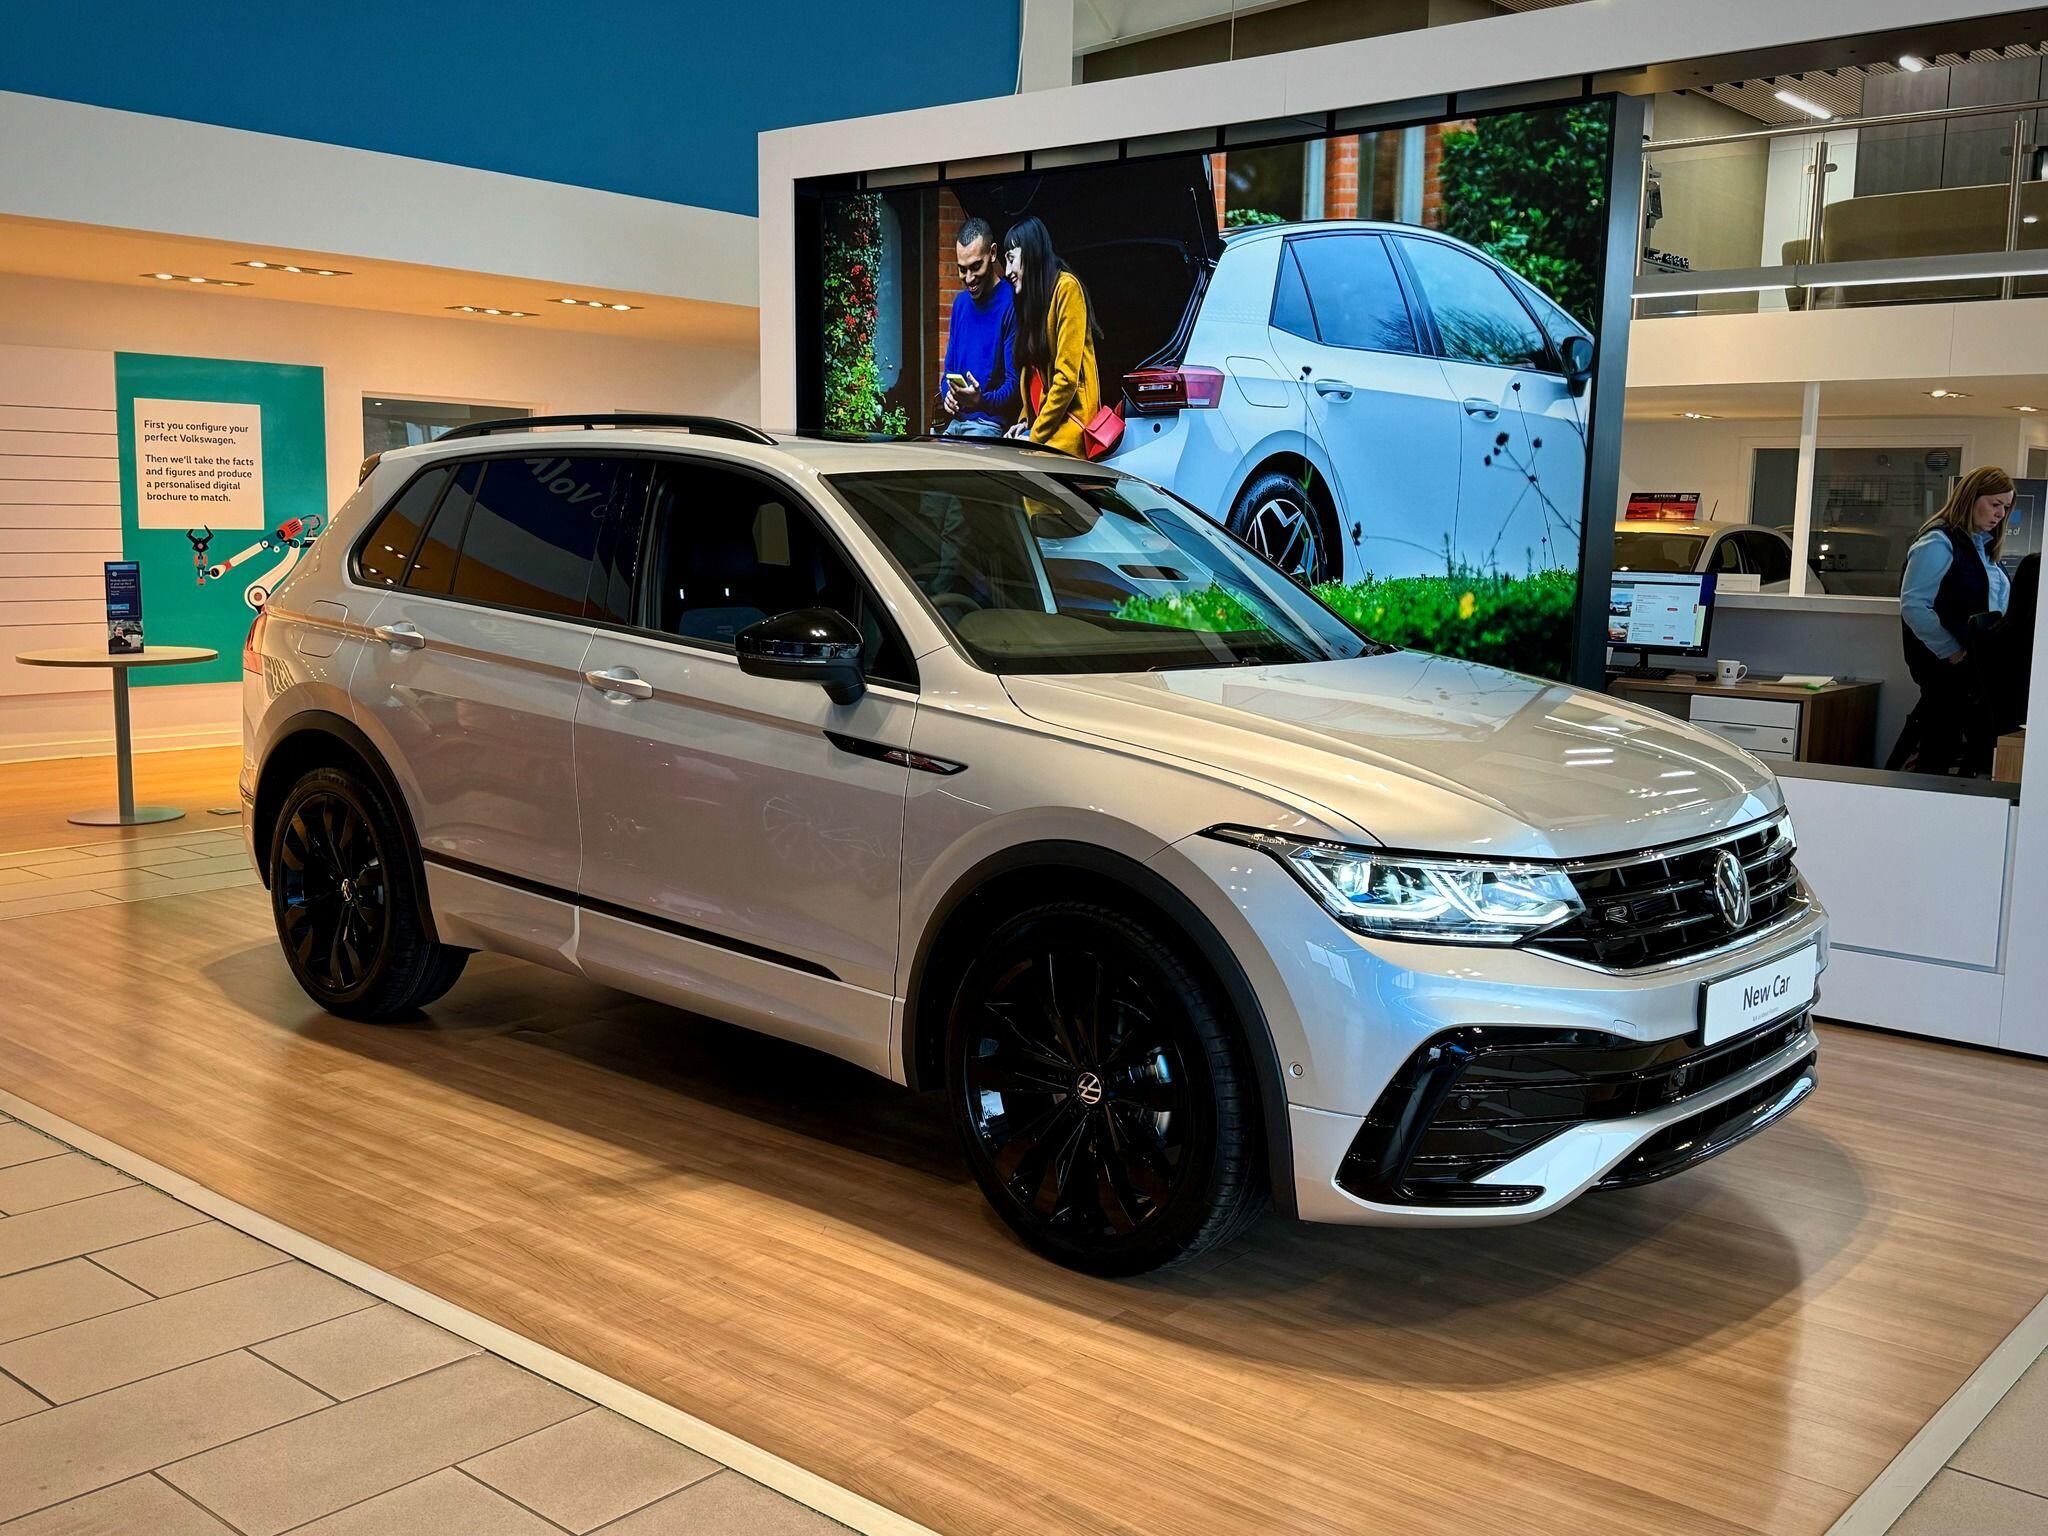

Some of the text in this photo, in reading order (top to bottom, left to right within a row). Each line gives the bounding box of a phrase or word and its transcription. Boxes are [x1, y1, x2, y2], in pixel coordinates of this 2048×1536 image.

[144, 420, 249, 434] First you configure your
[144, 433, 236, 446] perfect Volkswagen.
[145, 454, 254, 466] Then we'll take the facts
[146, 467, 253, 479] and figures and produce
[154, 480, 211, 490] personalised
[212, 481, 241, 491] digital
[147, 492, 187, 501] brochure
[201, 493, 231, 502] match.
[1743, 974, 1791, 1011] New Car
